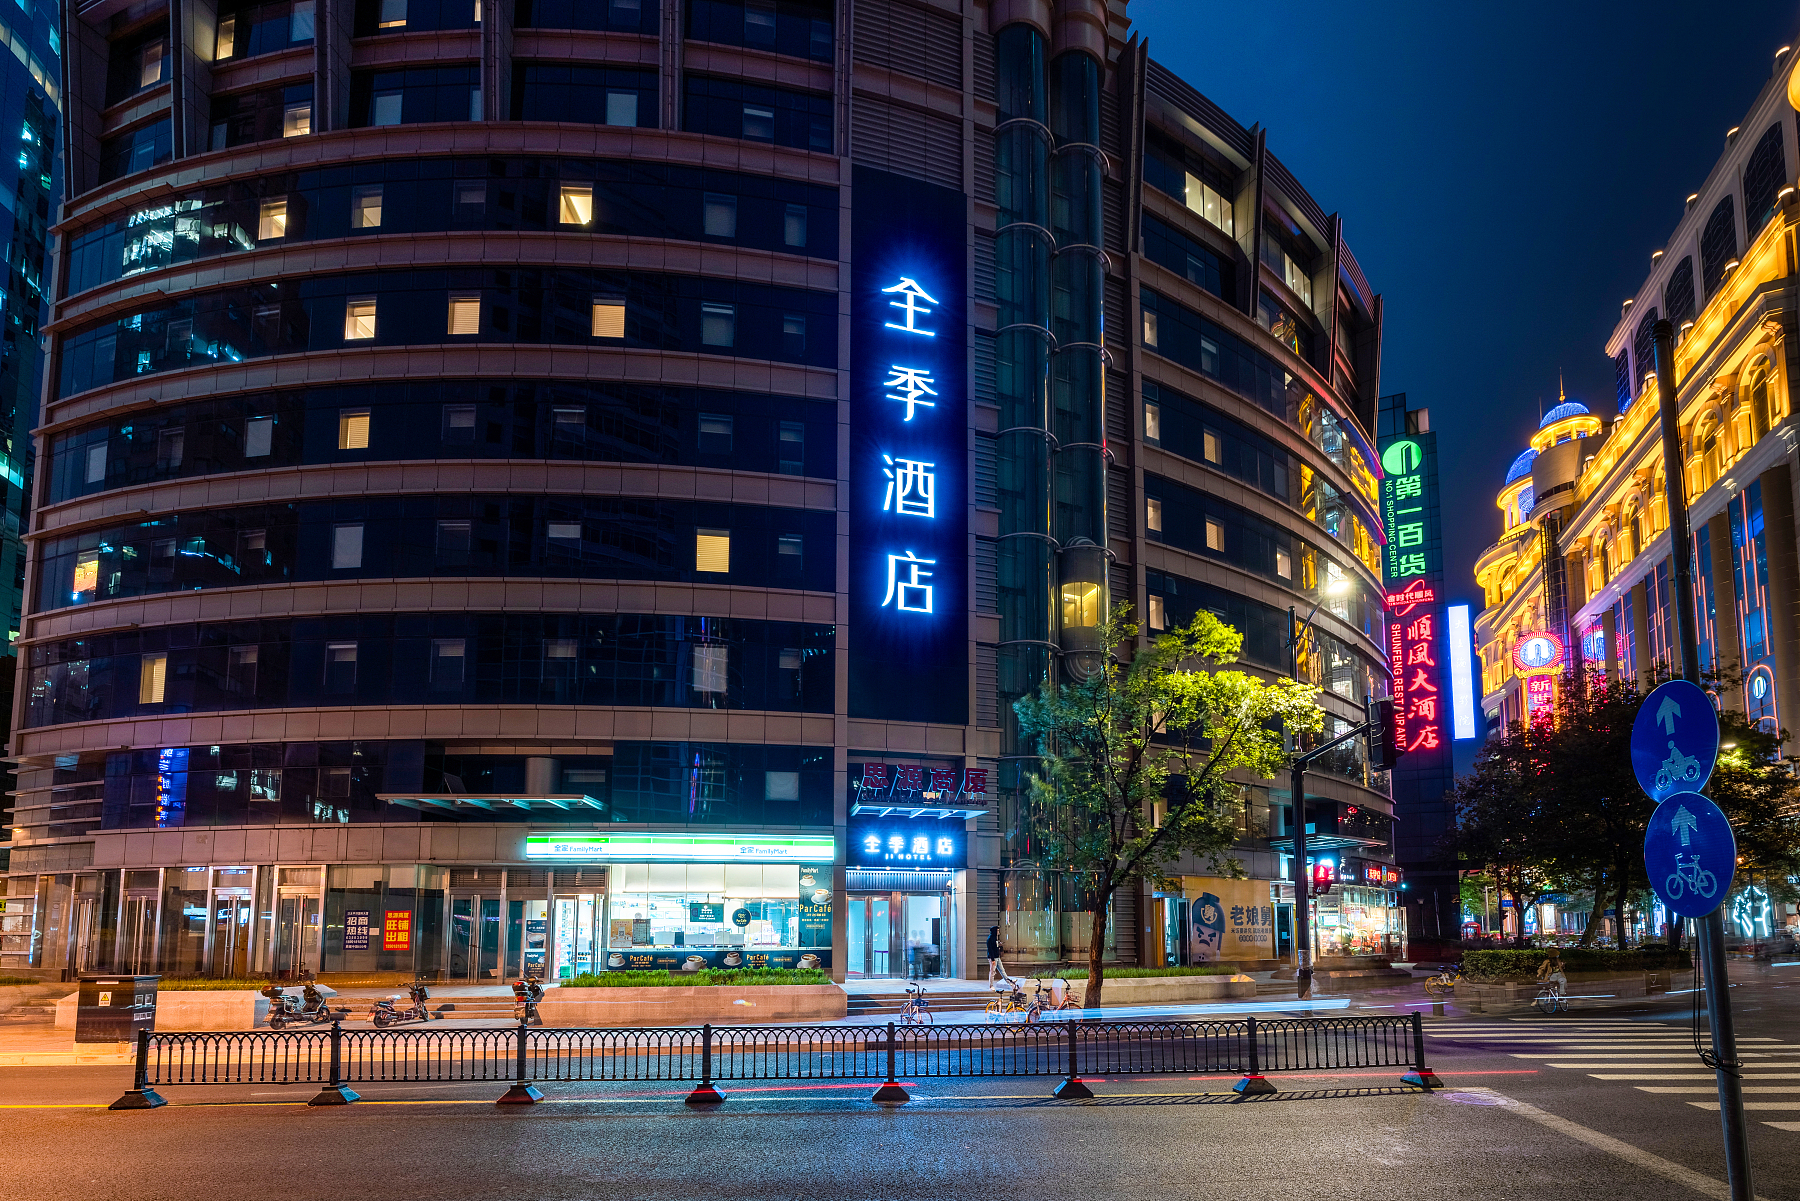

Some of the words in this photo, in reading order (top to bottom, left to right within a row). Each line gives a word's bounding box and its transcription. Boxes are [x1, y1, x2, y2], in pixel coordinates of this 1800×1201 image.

[881, 276, 939, 614] 全季酒店
[1385, 480, 1393, 499] NO.1
[1386, 500, 1396, 543] SHOPPING
[1396, 474, 1426, 577] 第一百货
[1389, 544, 1398, 578] CENTER
[1391, 623, 1403, 675] SHUNFENG
[863, 762, 988, 794] 思源商厦
[569, 846, 603, 854] FamilyMart
[755, 848, 788, 856] FamilyMart
[864, 836, 953, 854] 全季酒店
[799, 904, 832, 913] ParCafé
[1230, 905, 1272, 926] 老娘舅
[347, 917, 368, 925] 招商
[386, 920, 408, 930] 旺铺
[386, 932, 408, 941] 出租
[630, 954, 653, 962] ParCafé
[746, 953, 769, 961] ParCafé
